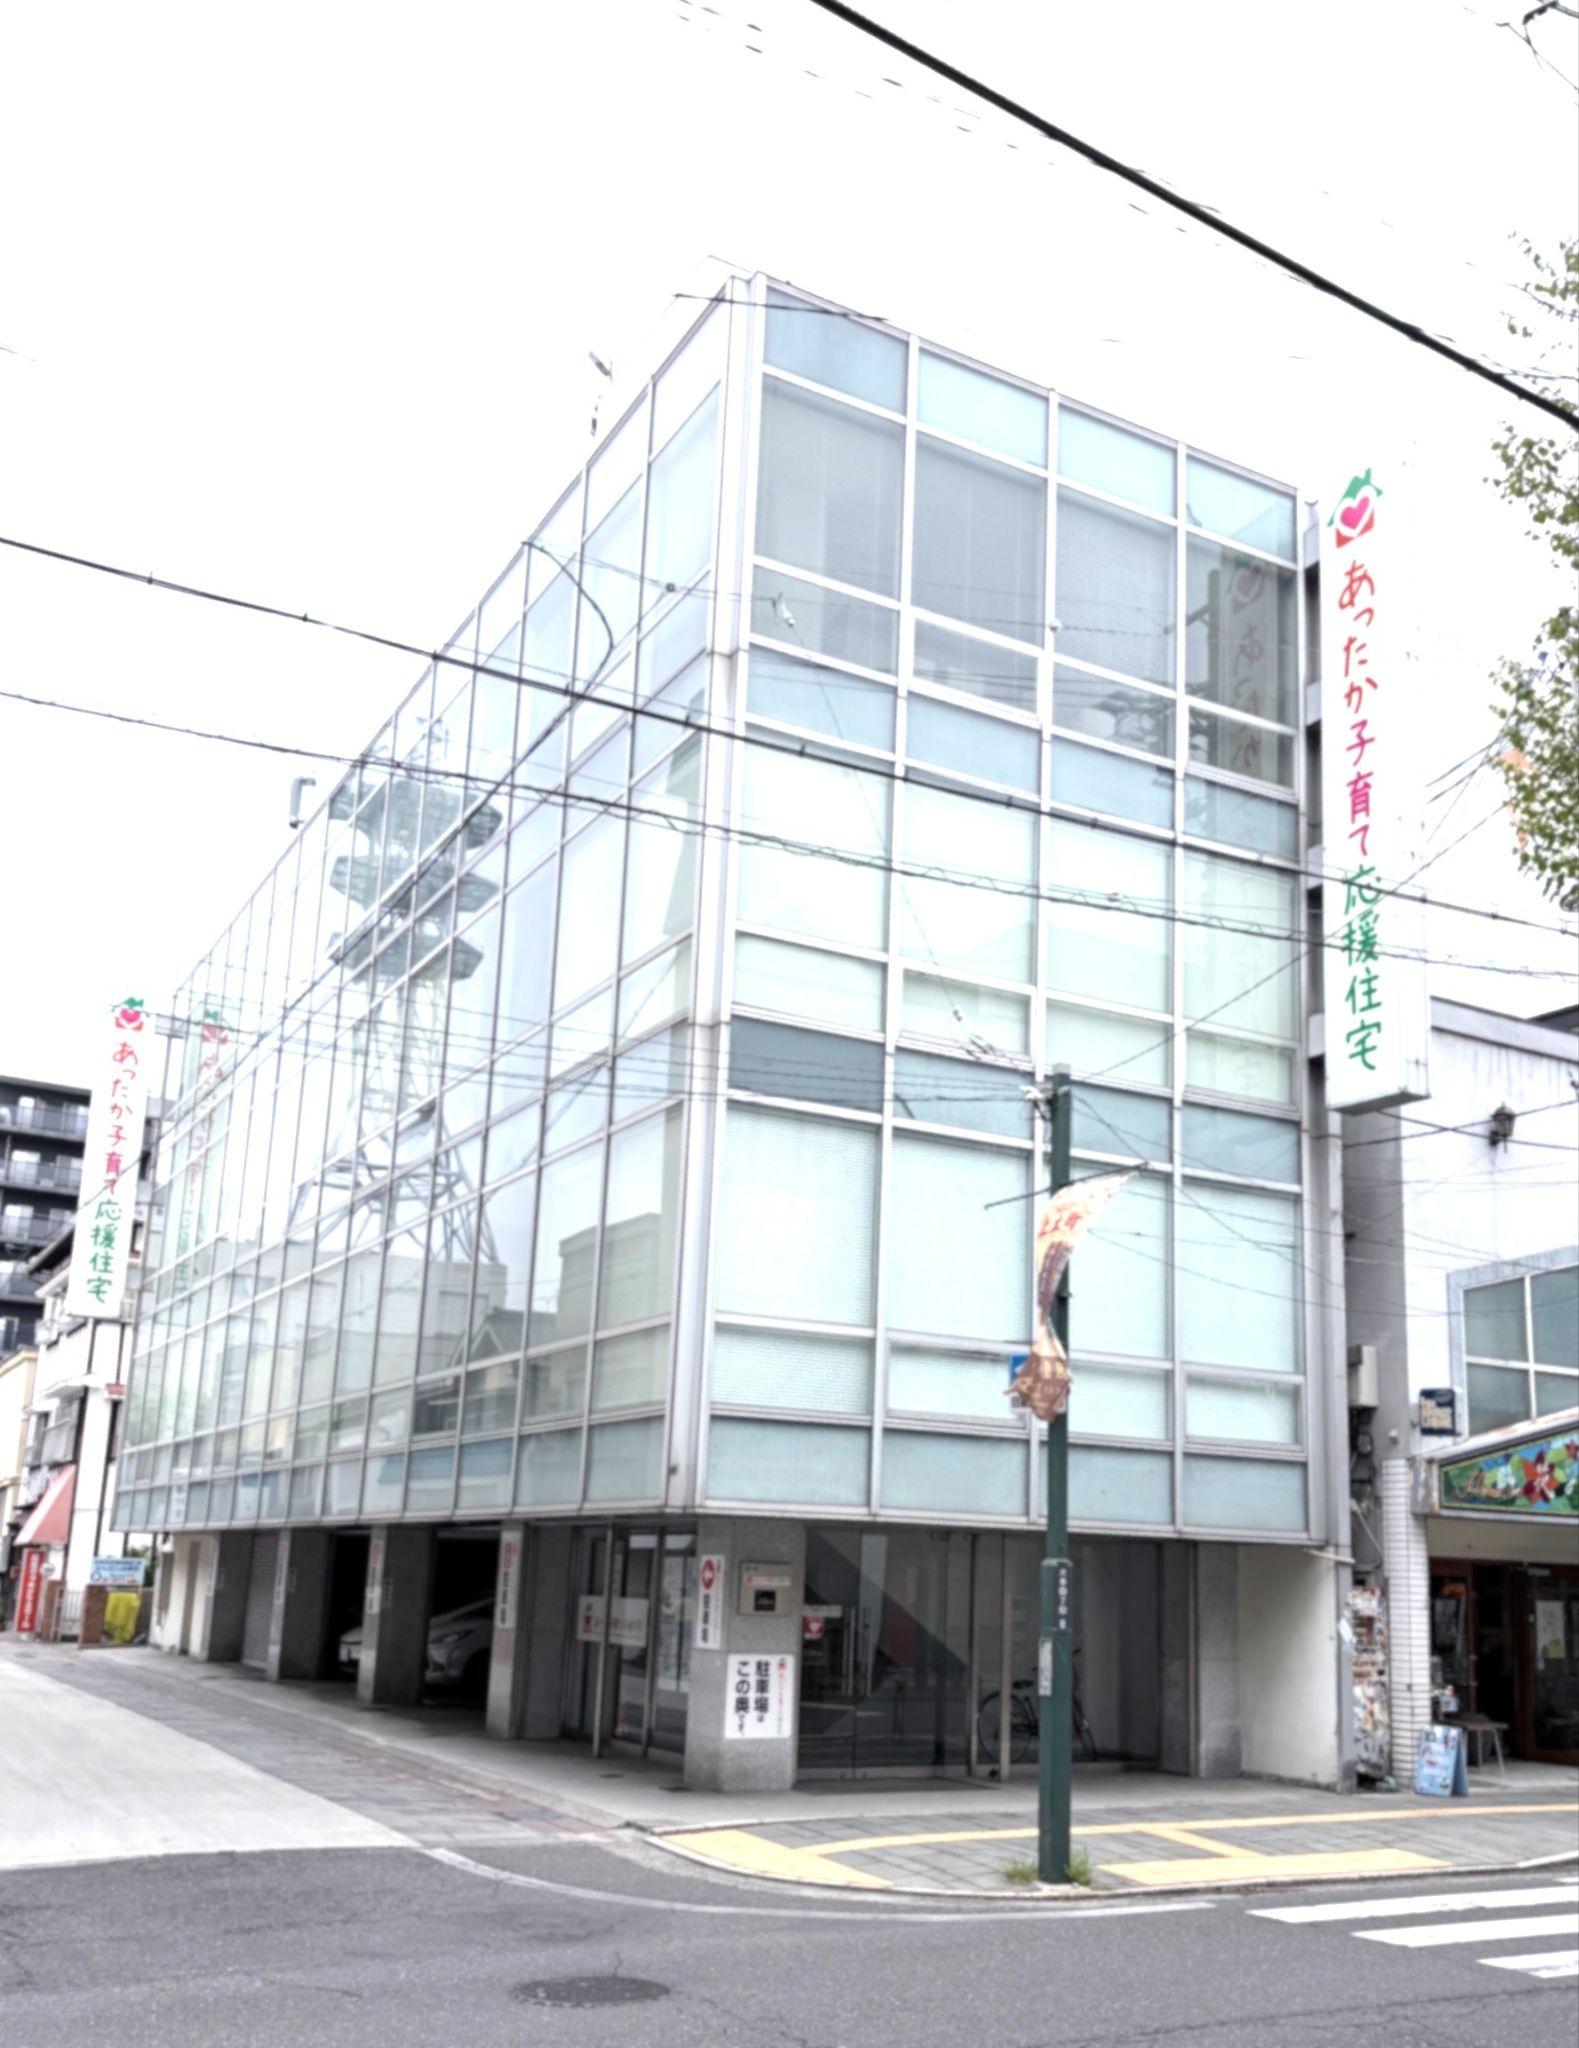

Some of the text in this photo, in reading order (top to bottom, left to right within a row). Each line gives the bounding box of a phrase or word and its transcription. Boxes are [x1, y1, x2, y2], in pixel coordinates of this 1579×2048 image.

[1338, 559, 1382, 1071] あったか子育て応援住宅
[87, 1042, 138, 1303] あったか子育て応援住宅
